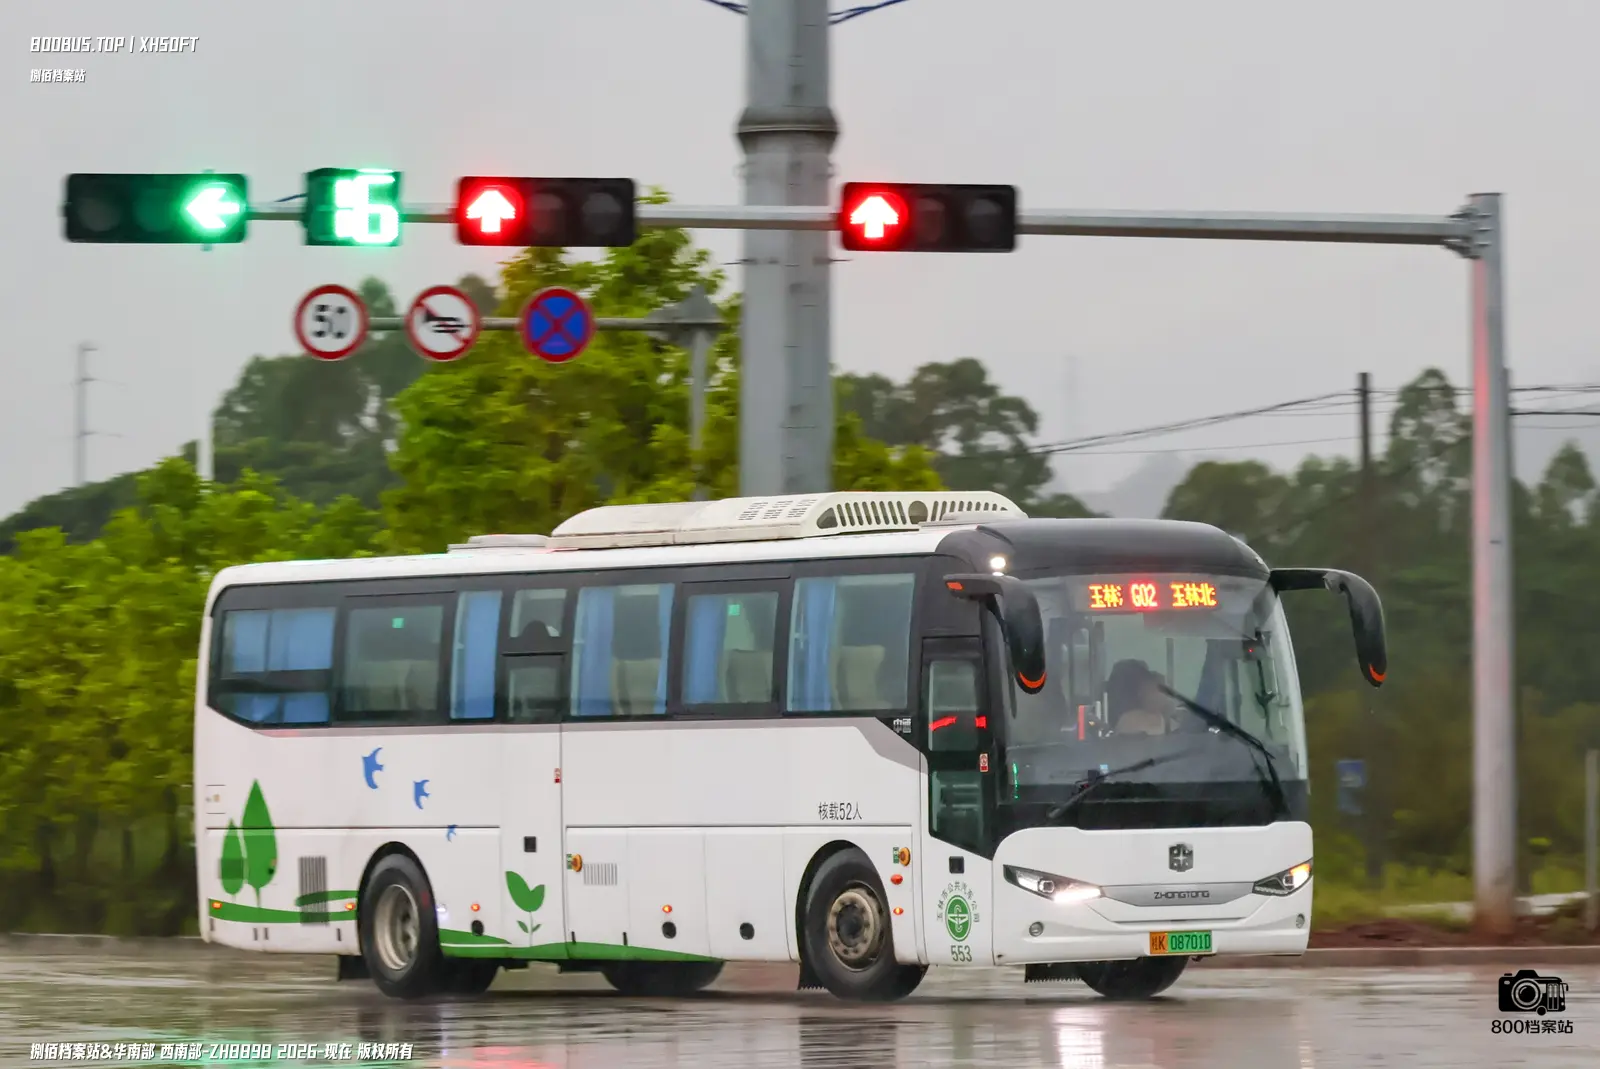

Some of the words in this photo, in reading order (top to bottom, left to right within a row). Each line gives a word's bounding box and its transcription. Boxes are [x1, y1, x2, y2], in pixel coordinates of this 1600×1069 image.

[312, 304, 353, 340] 50
[1170, 583, 1217, 607] 玉林北
[818, 801, 863, 821] 核载52人
[1153, 890, 1210, 900] ZHONGTONG
[950, 944, 973, 962] 553
